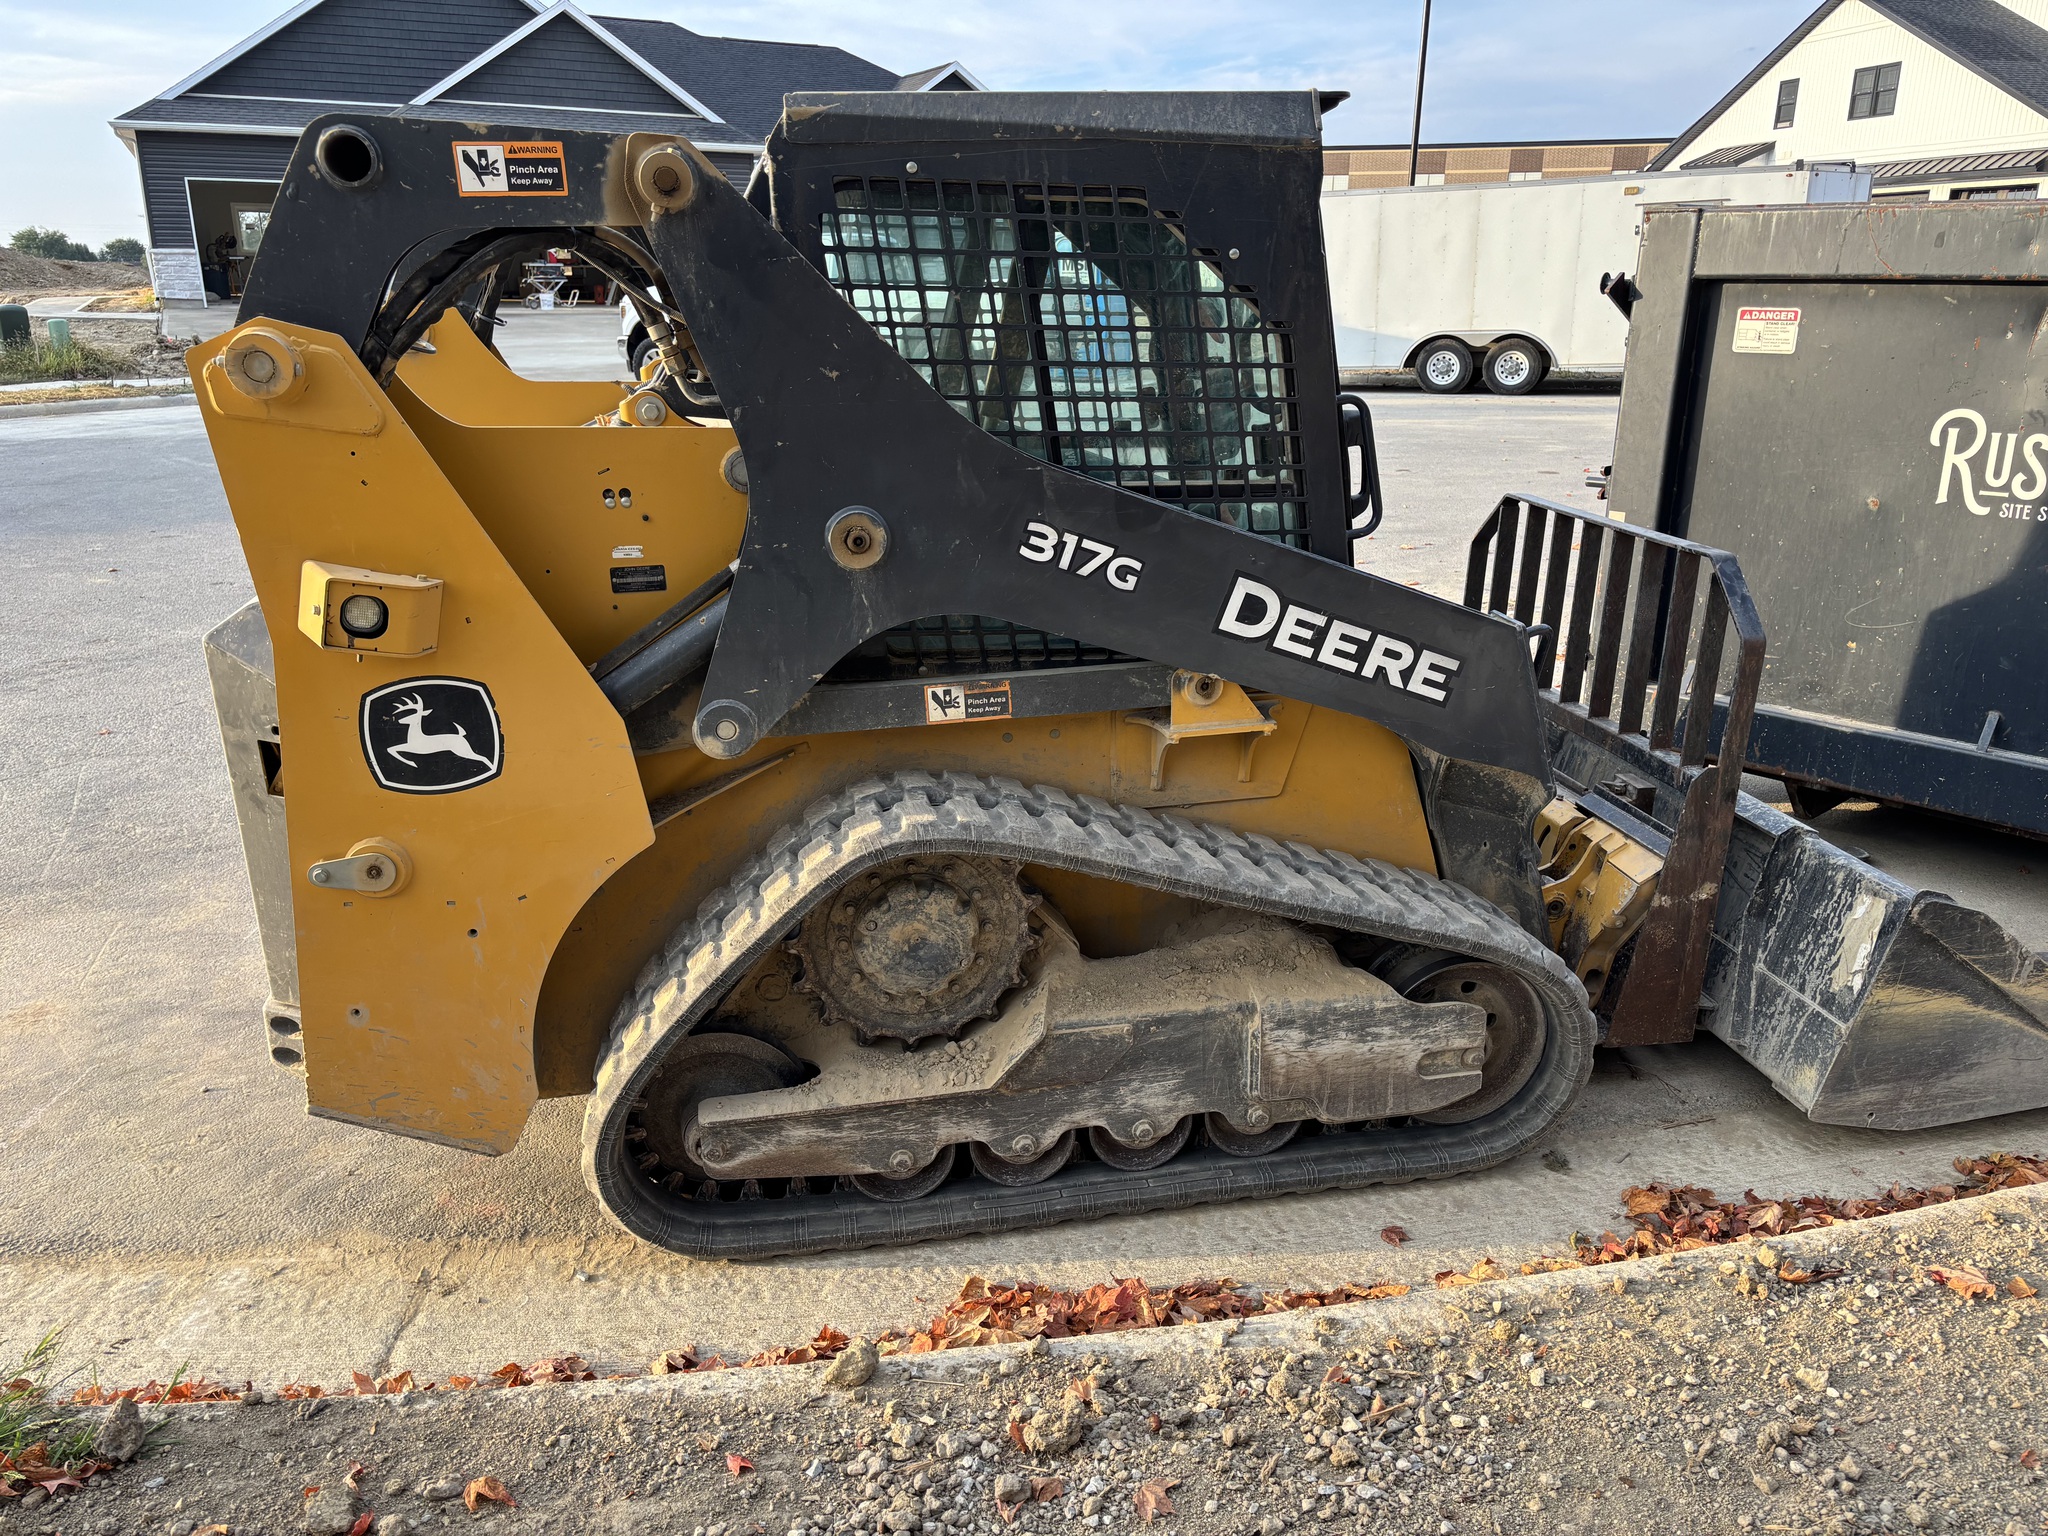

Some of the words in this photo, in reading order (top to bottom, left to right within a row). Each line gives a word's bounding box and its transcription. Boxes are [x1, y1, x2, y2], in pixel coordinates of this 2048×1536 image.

[517, 146, 558, 154] WARNING
[509, 165, 536, 174] Pinch
[537, 165, 559, 174] Area
[511, 177, 531, 186] Keep
[532, 177, 553, 186] Away
[1752, 311, 1795, 320] DANGER
[1999, 502, 2033, 521] SITE
[1019, 521, 1144, 592] 317G
[1218, 576, 1461, 703] DEERE
[967, 697, 988, 705] Pinch
[989, 696, 1006, 704] Area
[968, 706, 984, 714] Keep
[984, 705, 1001, 713] Away
